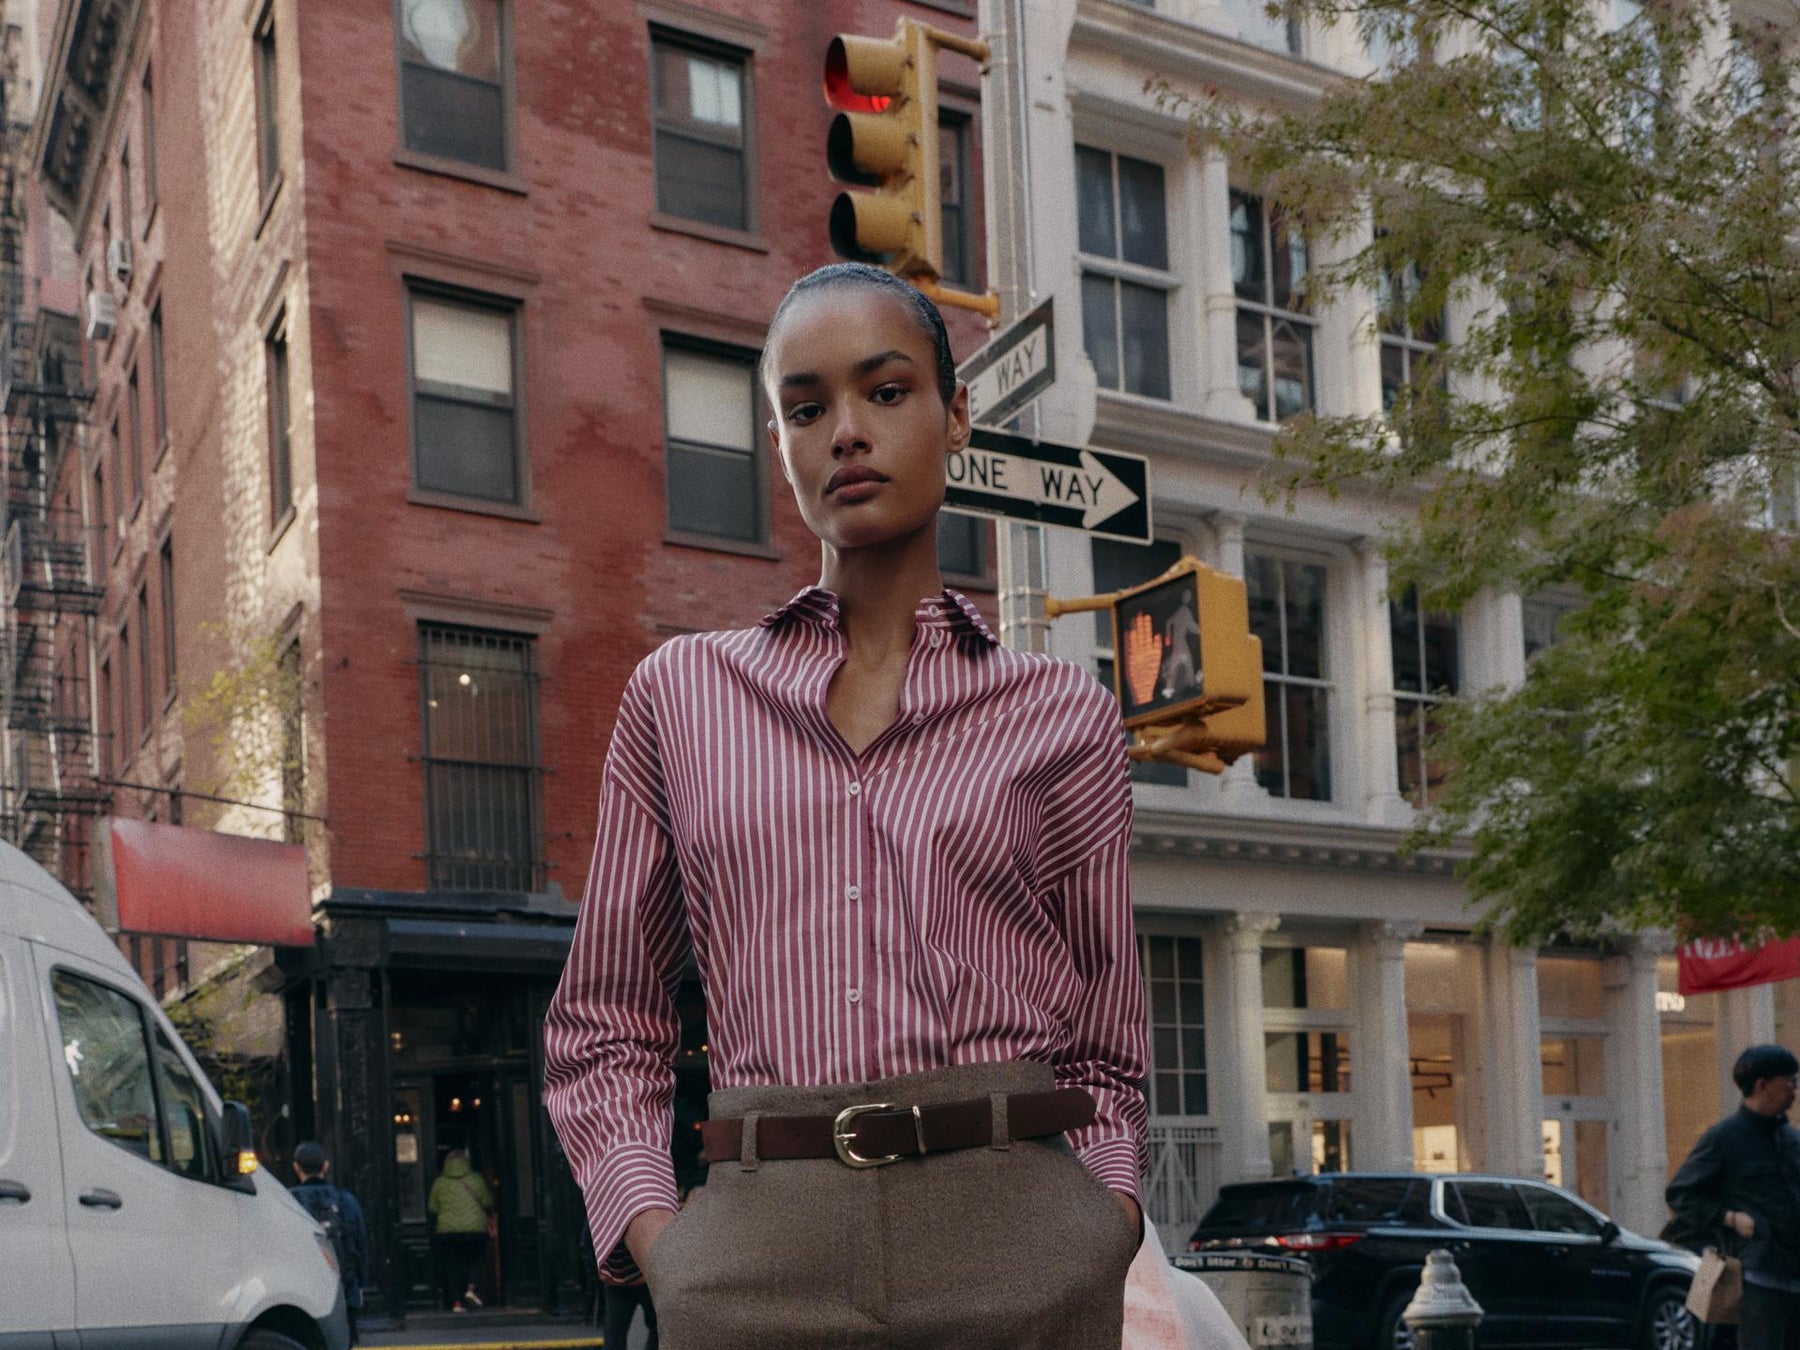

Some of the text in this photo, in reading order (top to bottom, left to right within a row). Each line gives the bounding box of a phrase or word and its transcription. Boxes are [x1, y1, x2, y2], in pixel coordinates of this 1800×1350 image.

[997, 337, 1037, 395] WAY
[947, 452, 1103, 506] ONE WAY
